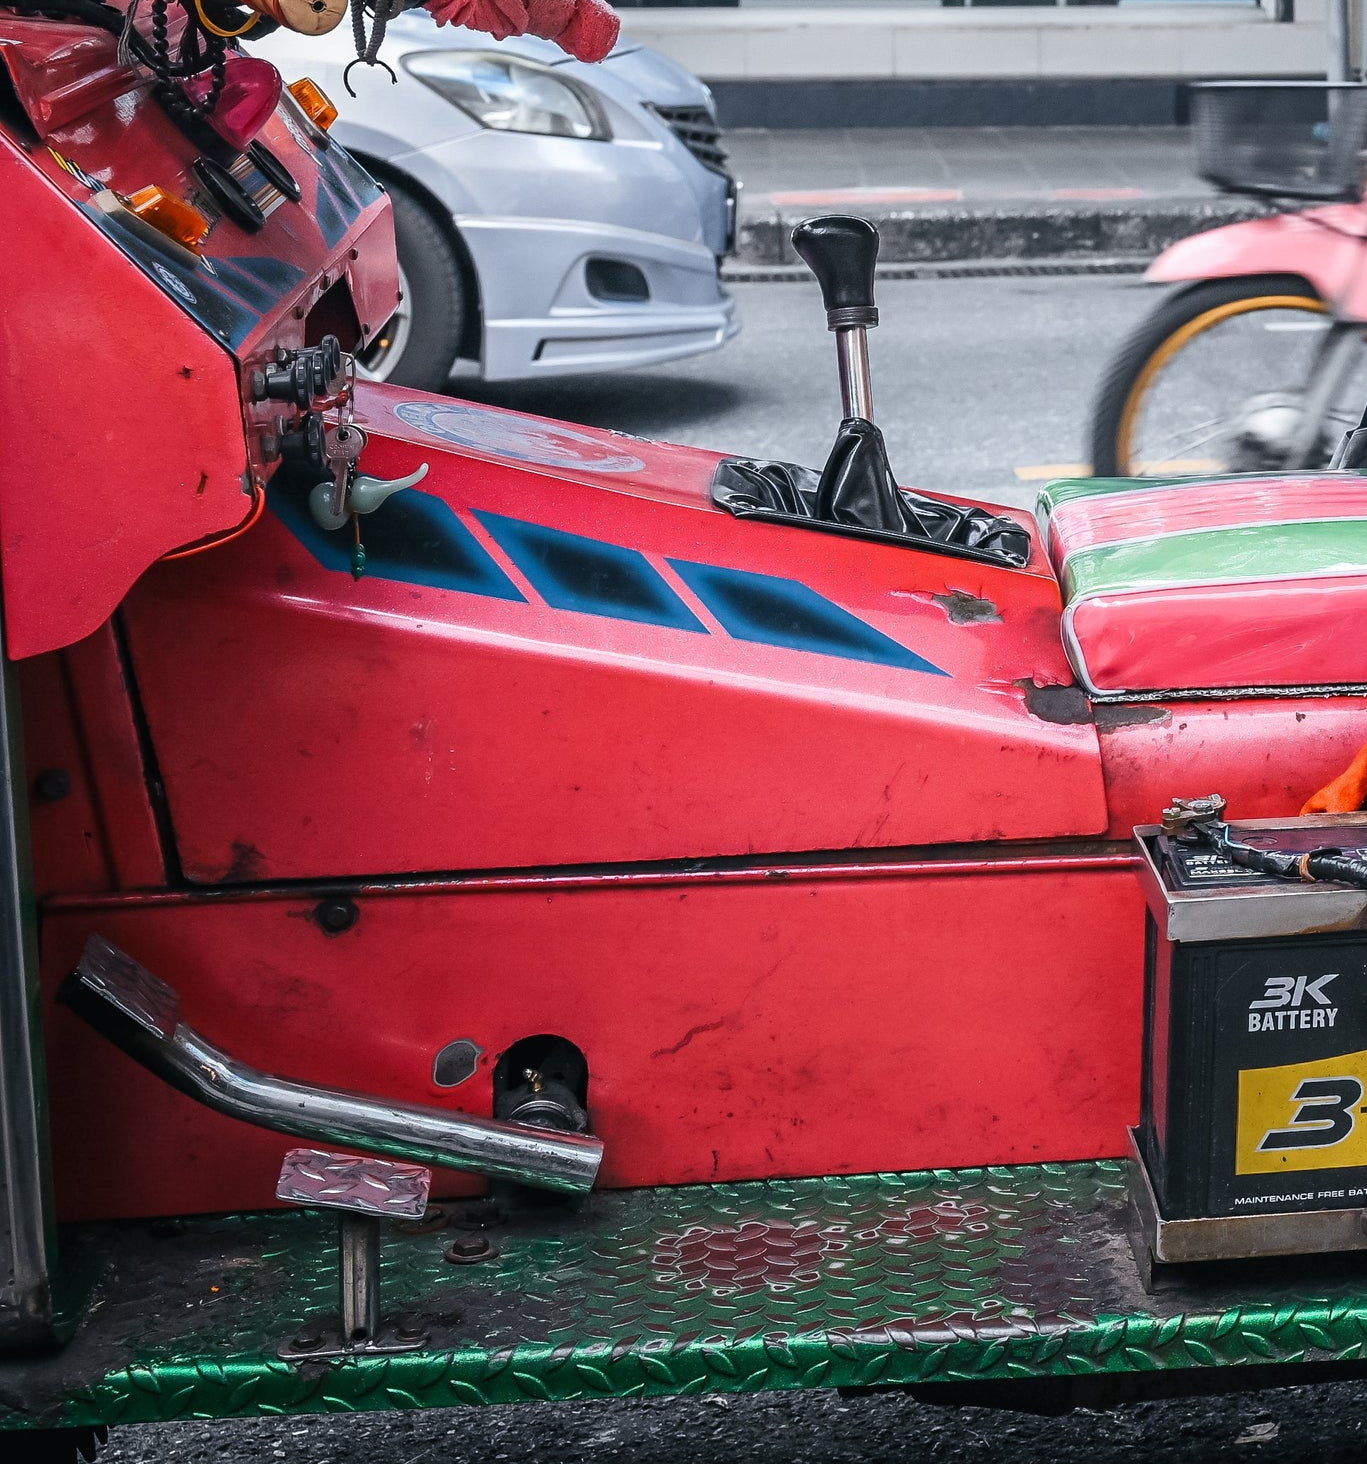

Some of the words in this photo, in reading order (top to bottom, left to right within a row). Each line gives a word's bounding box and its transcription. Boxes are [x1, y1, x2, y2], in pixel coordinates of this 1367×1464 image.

[1249, 973, 1340, 1009] 3K
[1248, 1008, 1339, 1032] BATTERY
[1234, 1192, 1315, 1206] MAINTENANCE
[1317, 1190, 1346, 1198] FREE
